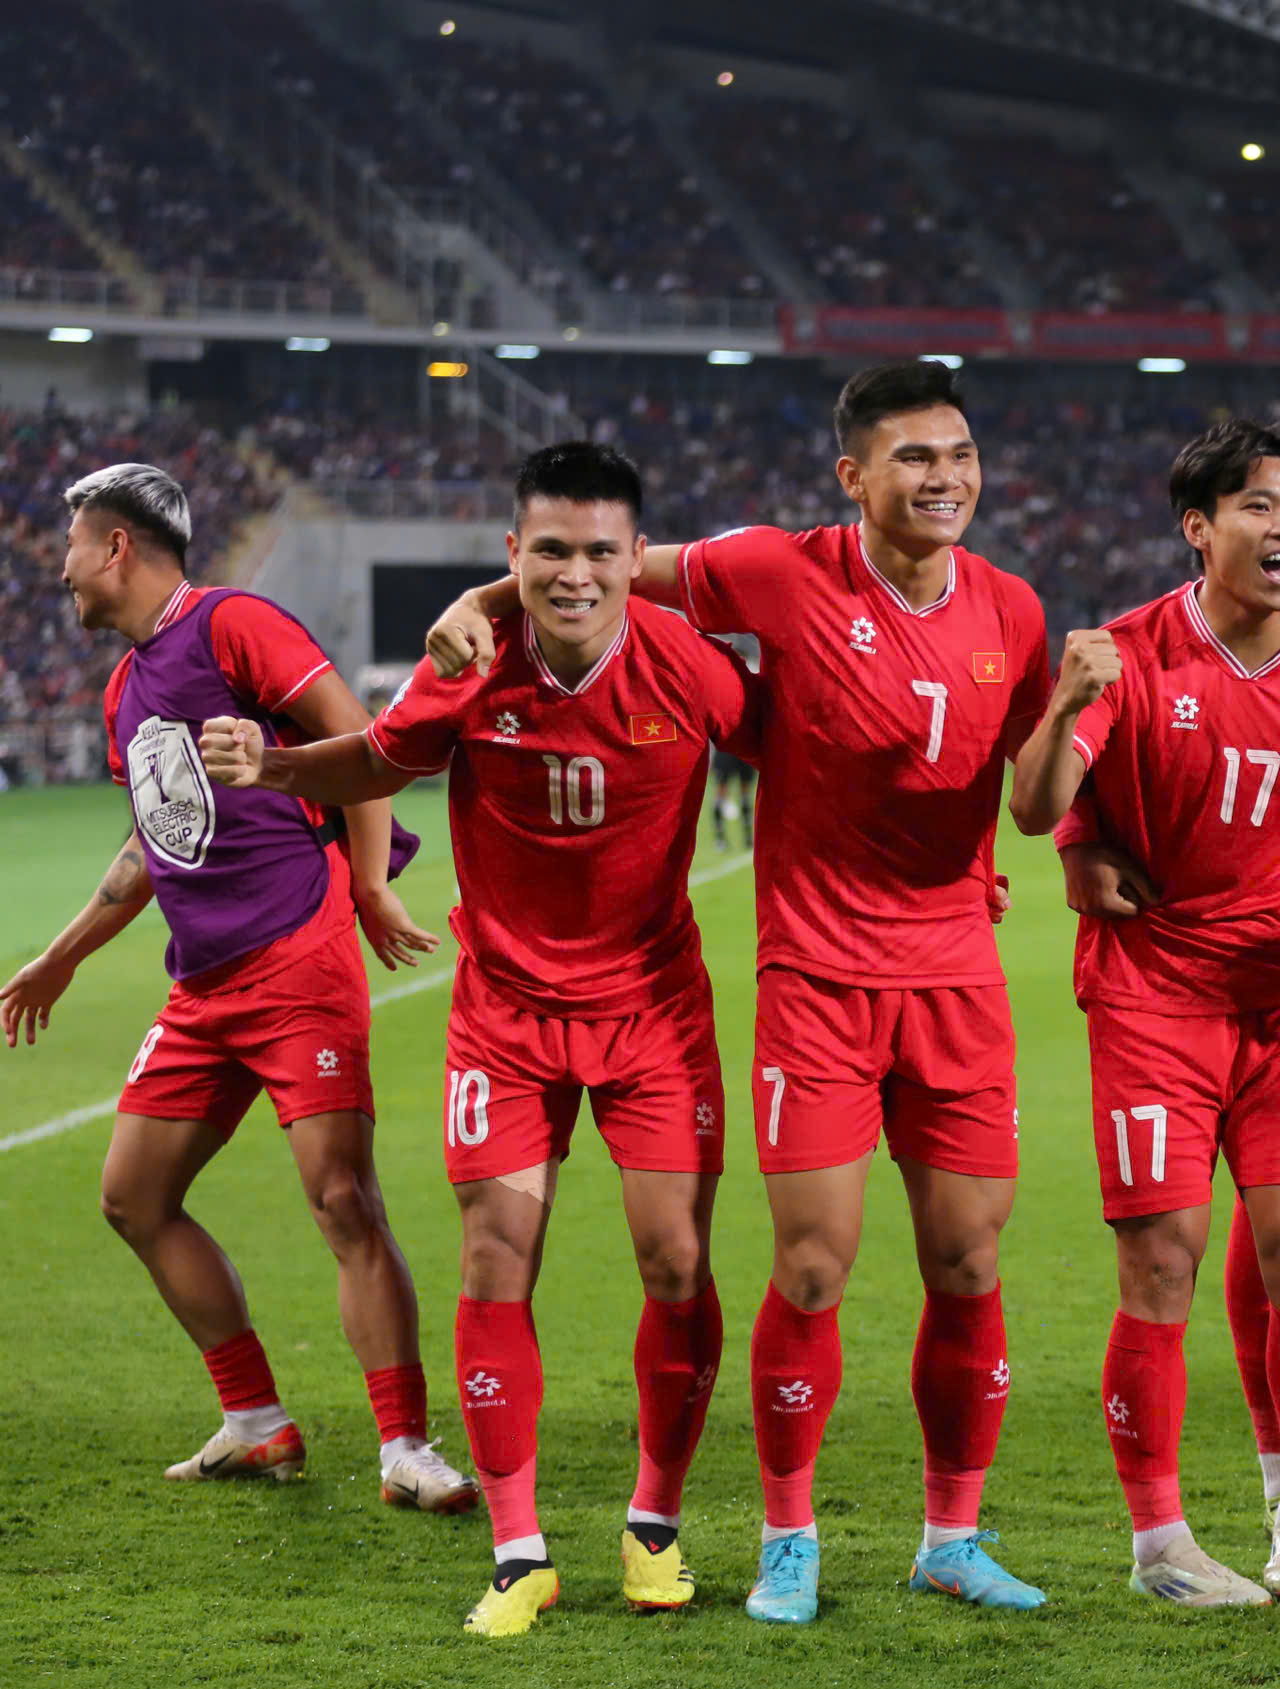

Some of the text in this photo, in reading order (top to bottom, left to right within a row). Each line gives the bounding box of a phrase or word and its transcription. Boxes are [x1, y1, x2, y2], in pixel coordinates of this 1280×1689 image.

[911, 680, 948, 763] 7
[542, 755, 605, 827] 10
[165, 827, 192, 847] CUP
[448, 1069, 490, 1148] 10
[762, 1066, 786, 1146] 7
[1110, 1103, 1168, 1186] 17
